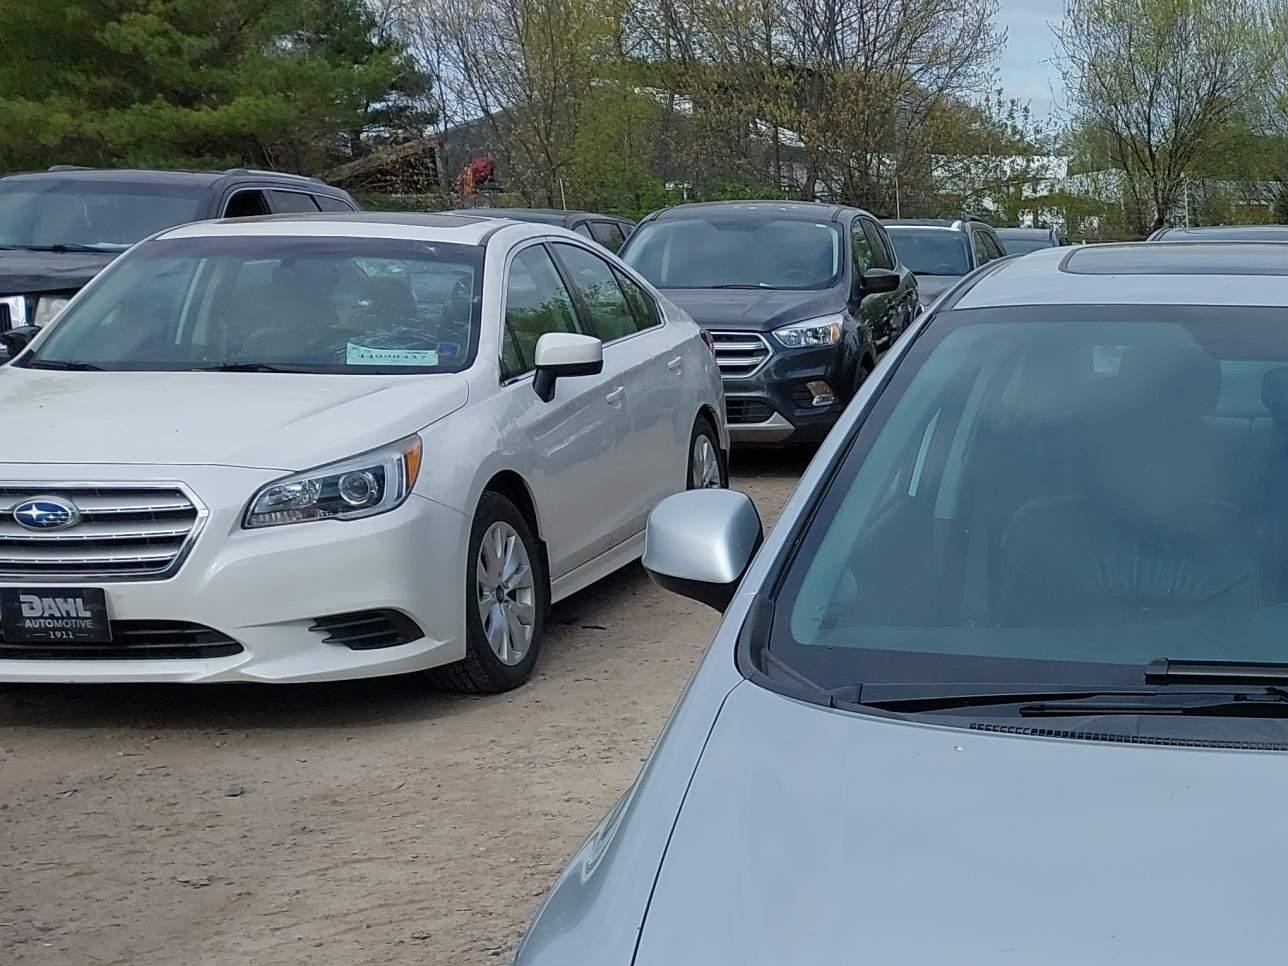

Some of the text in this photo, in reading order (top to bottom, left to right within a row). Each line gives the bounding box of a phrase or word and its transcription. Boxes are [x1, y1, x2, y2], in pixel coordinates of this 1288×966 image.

[19, 594, 92, 617] DAHL
[25, 619, 94, 629] AUTOMOTIVE
[48, 631, 74, 639] 1911
